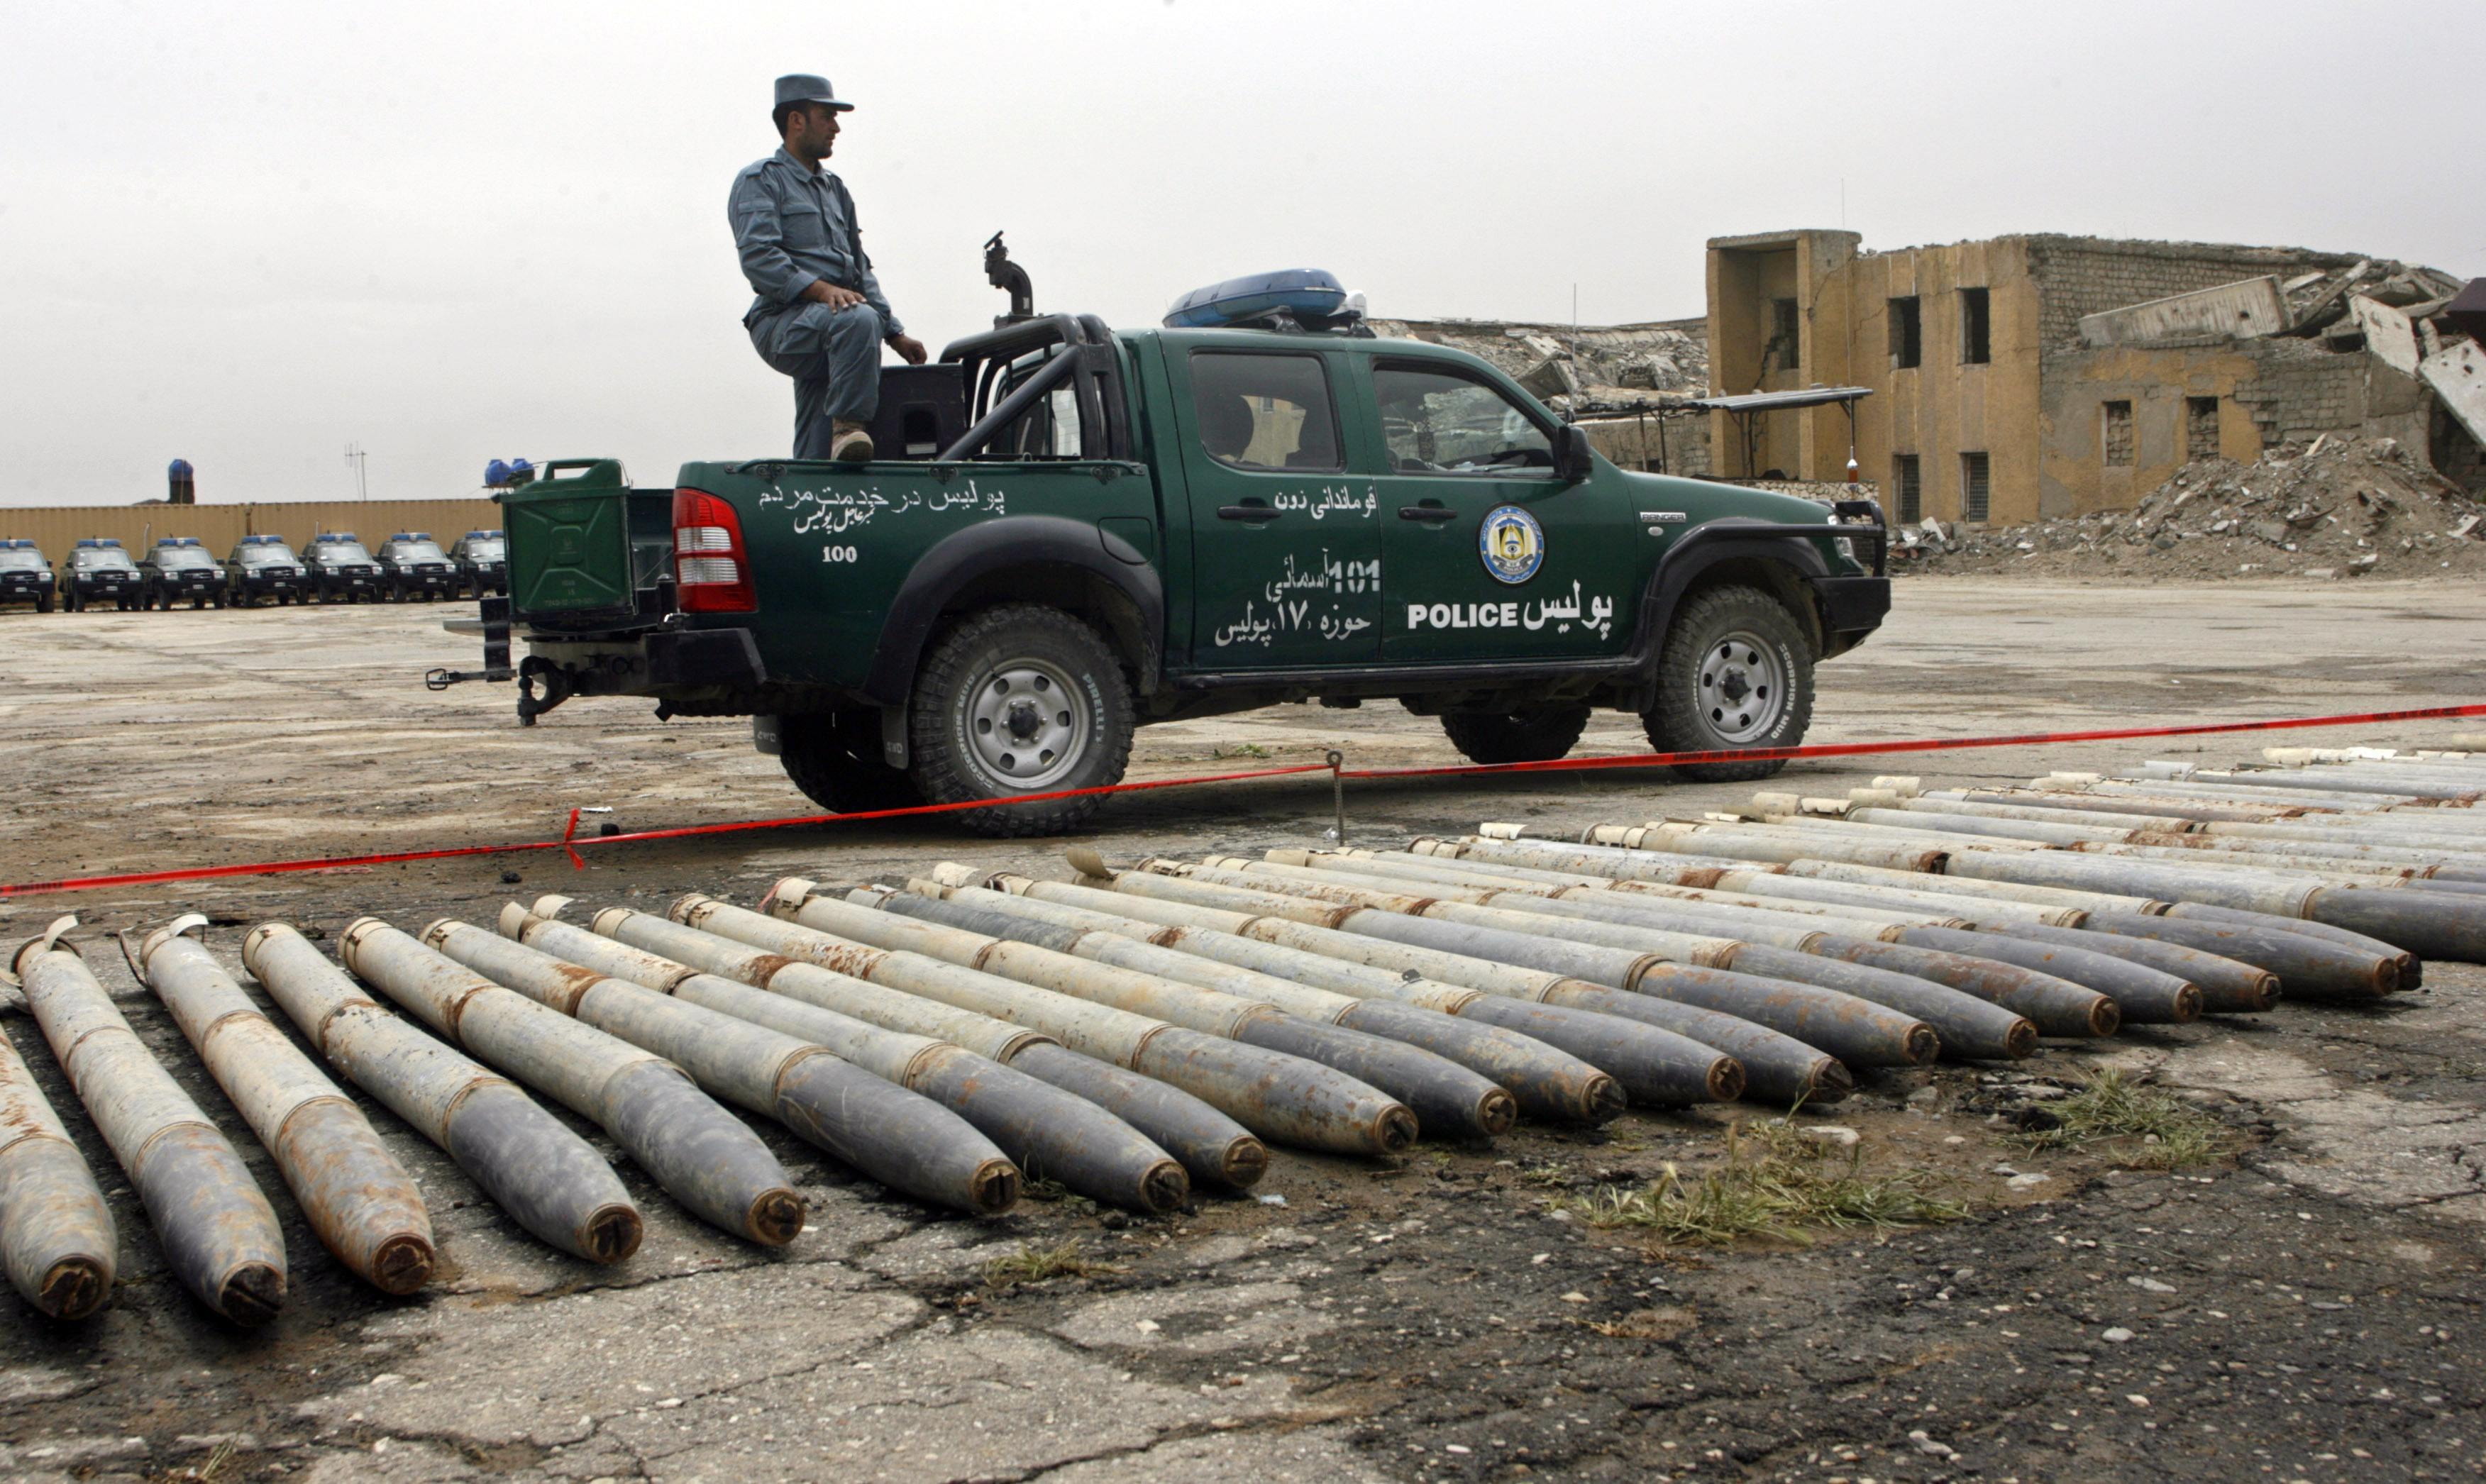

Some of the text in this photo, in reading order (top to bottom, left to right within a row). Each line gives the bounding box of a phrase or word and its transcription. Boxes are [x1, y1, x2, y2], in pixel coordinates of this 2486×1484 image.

[759, 485, 814, 511] مردم
[816, 486, 888, 504] خدمت
[891, 490, 921, 513] در
[1274, 490, 1307, 510] زون
[794, 504, 832, 534] پولیس
[822, 546, 858, 563] 100
[1329, 559, 1380, 594] 101
[1215, 600, 1272, 647] پولیس
[1320, 604, 1371, 640] حوزه
[1408, 602, 1518, 629] POLICE
[1523, 579, 1612, 641] پولیس
[1082, 673, 1104, 730] PIRELLI
[1771, 643, 1796, 738] SCORPION MUD
[955, 675, 994, 789] SCORPION MUD
